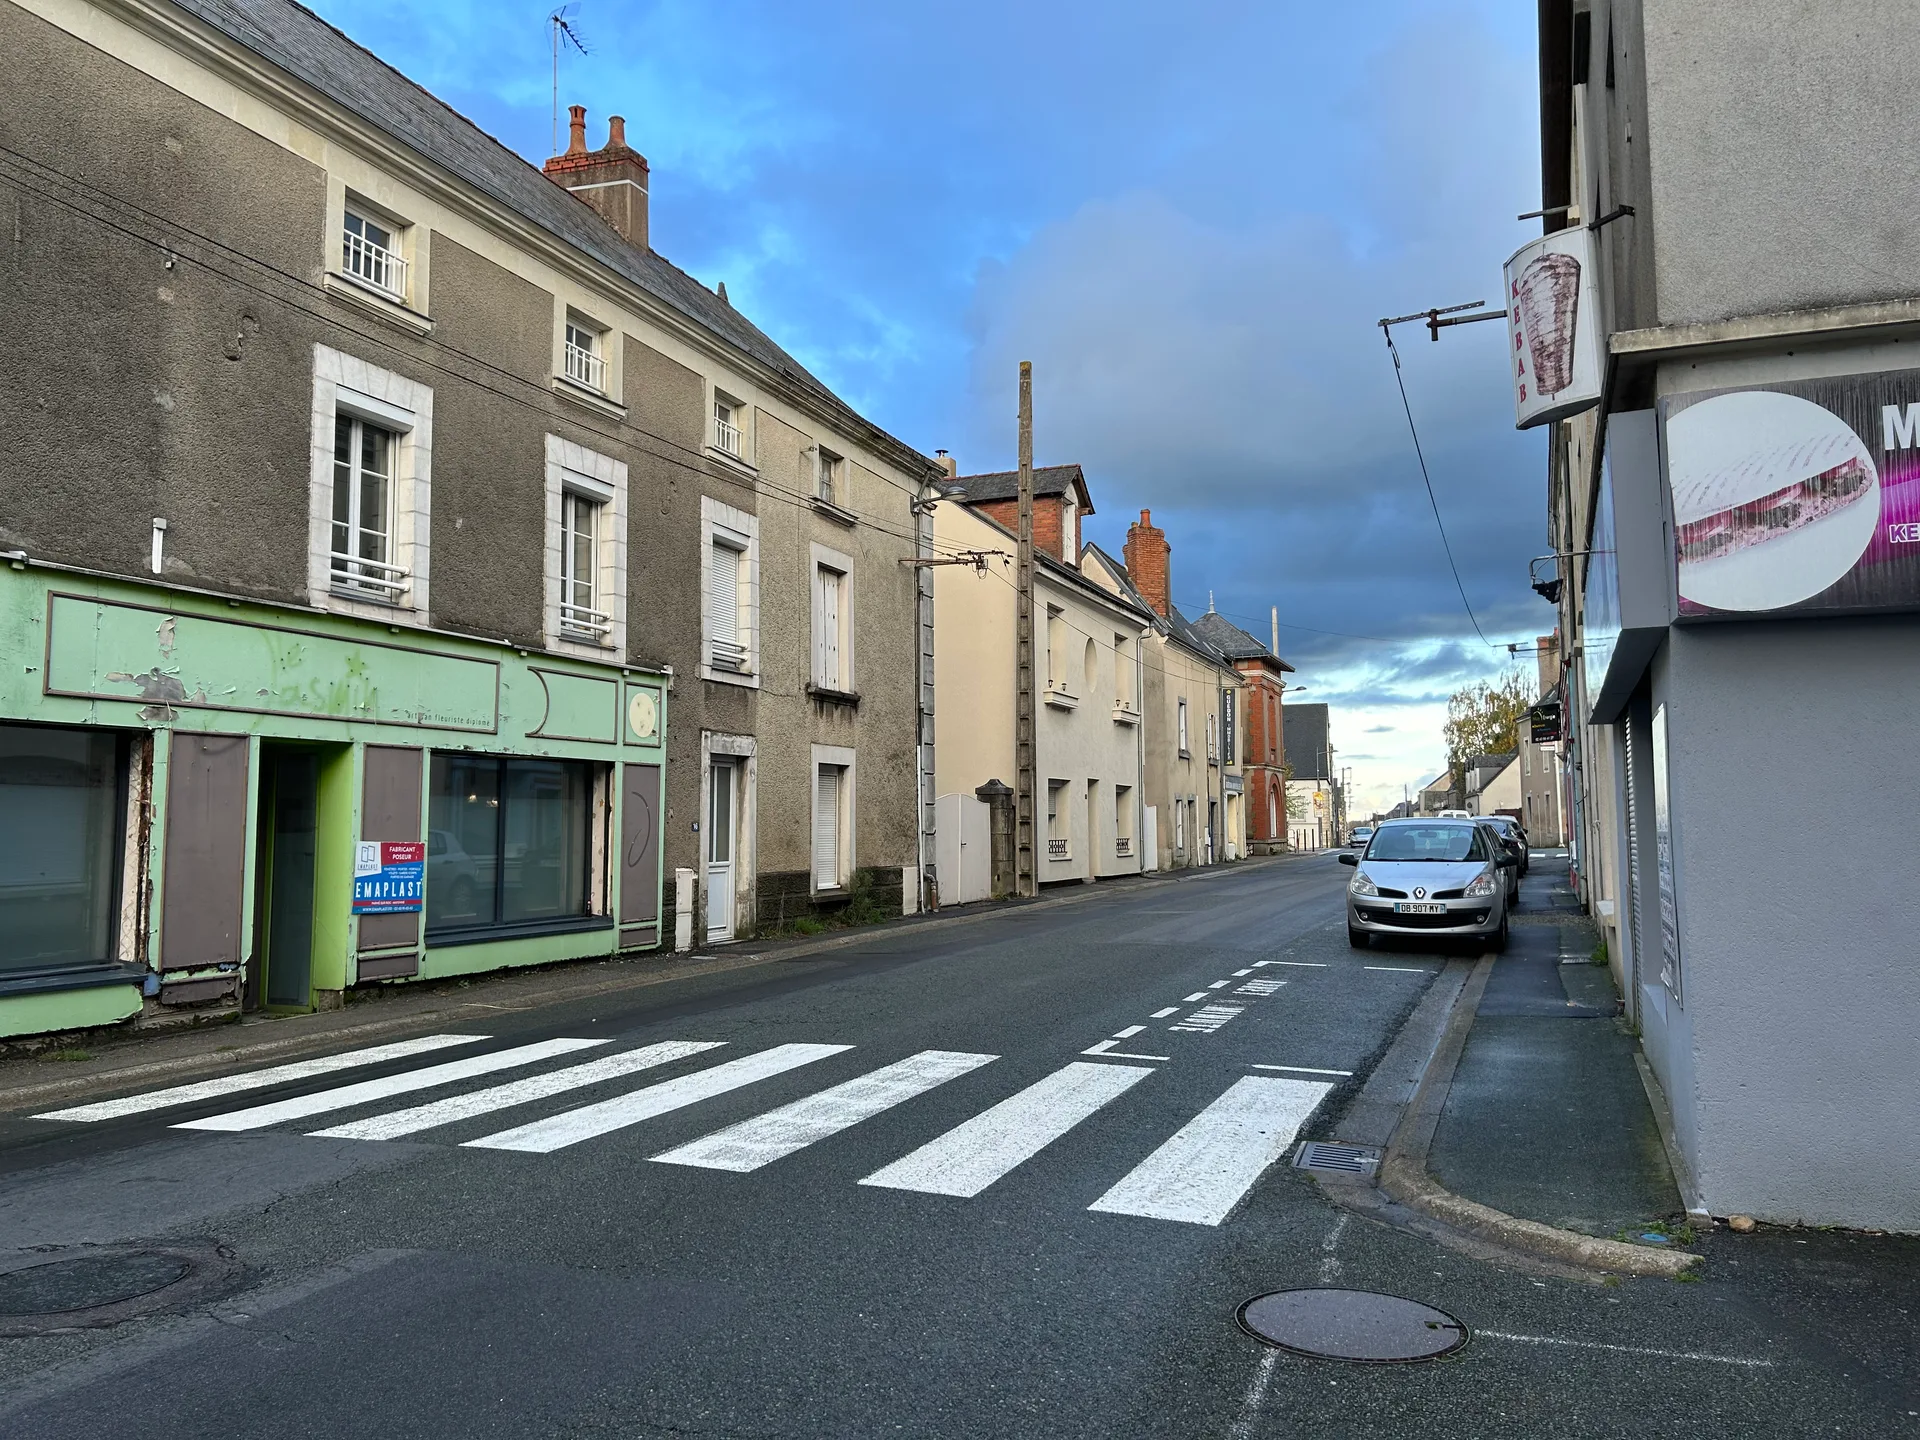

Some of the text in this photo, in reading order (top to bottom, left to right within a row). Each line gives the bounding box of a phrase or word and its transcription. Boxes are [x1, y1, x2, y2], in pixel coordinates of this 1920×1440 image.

[1511, 277, 1527, 404] KEBAB
[434, 713, 464, 724] fleuriste
[355, 881, 422, 898] EMAPLAST
